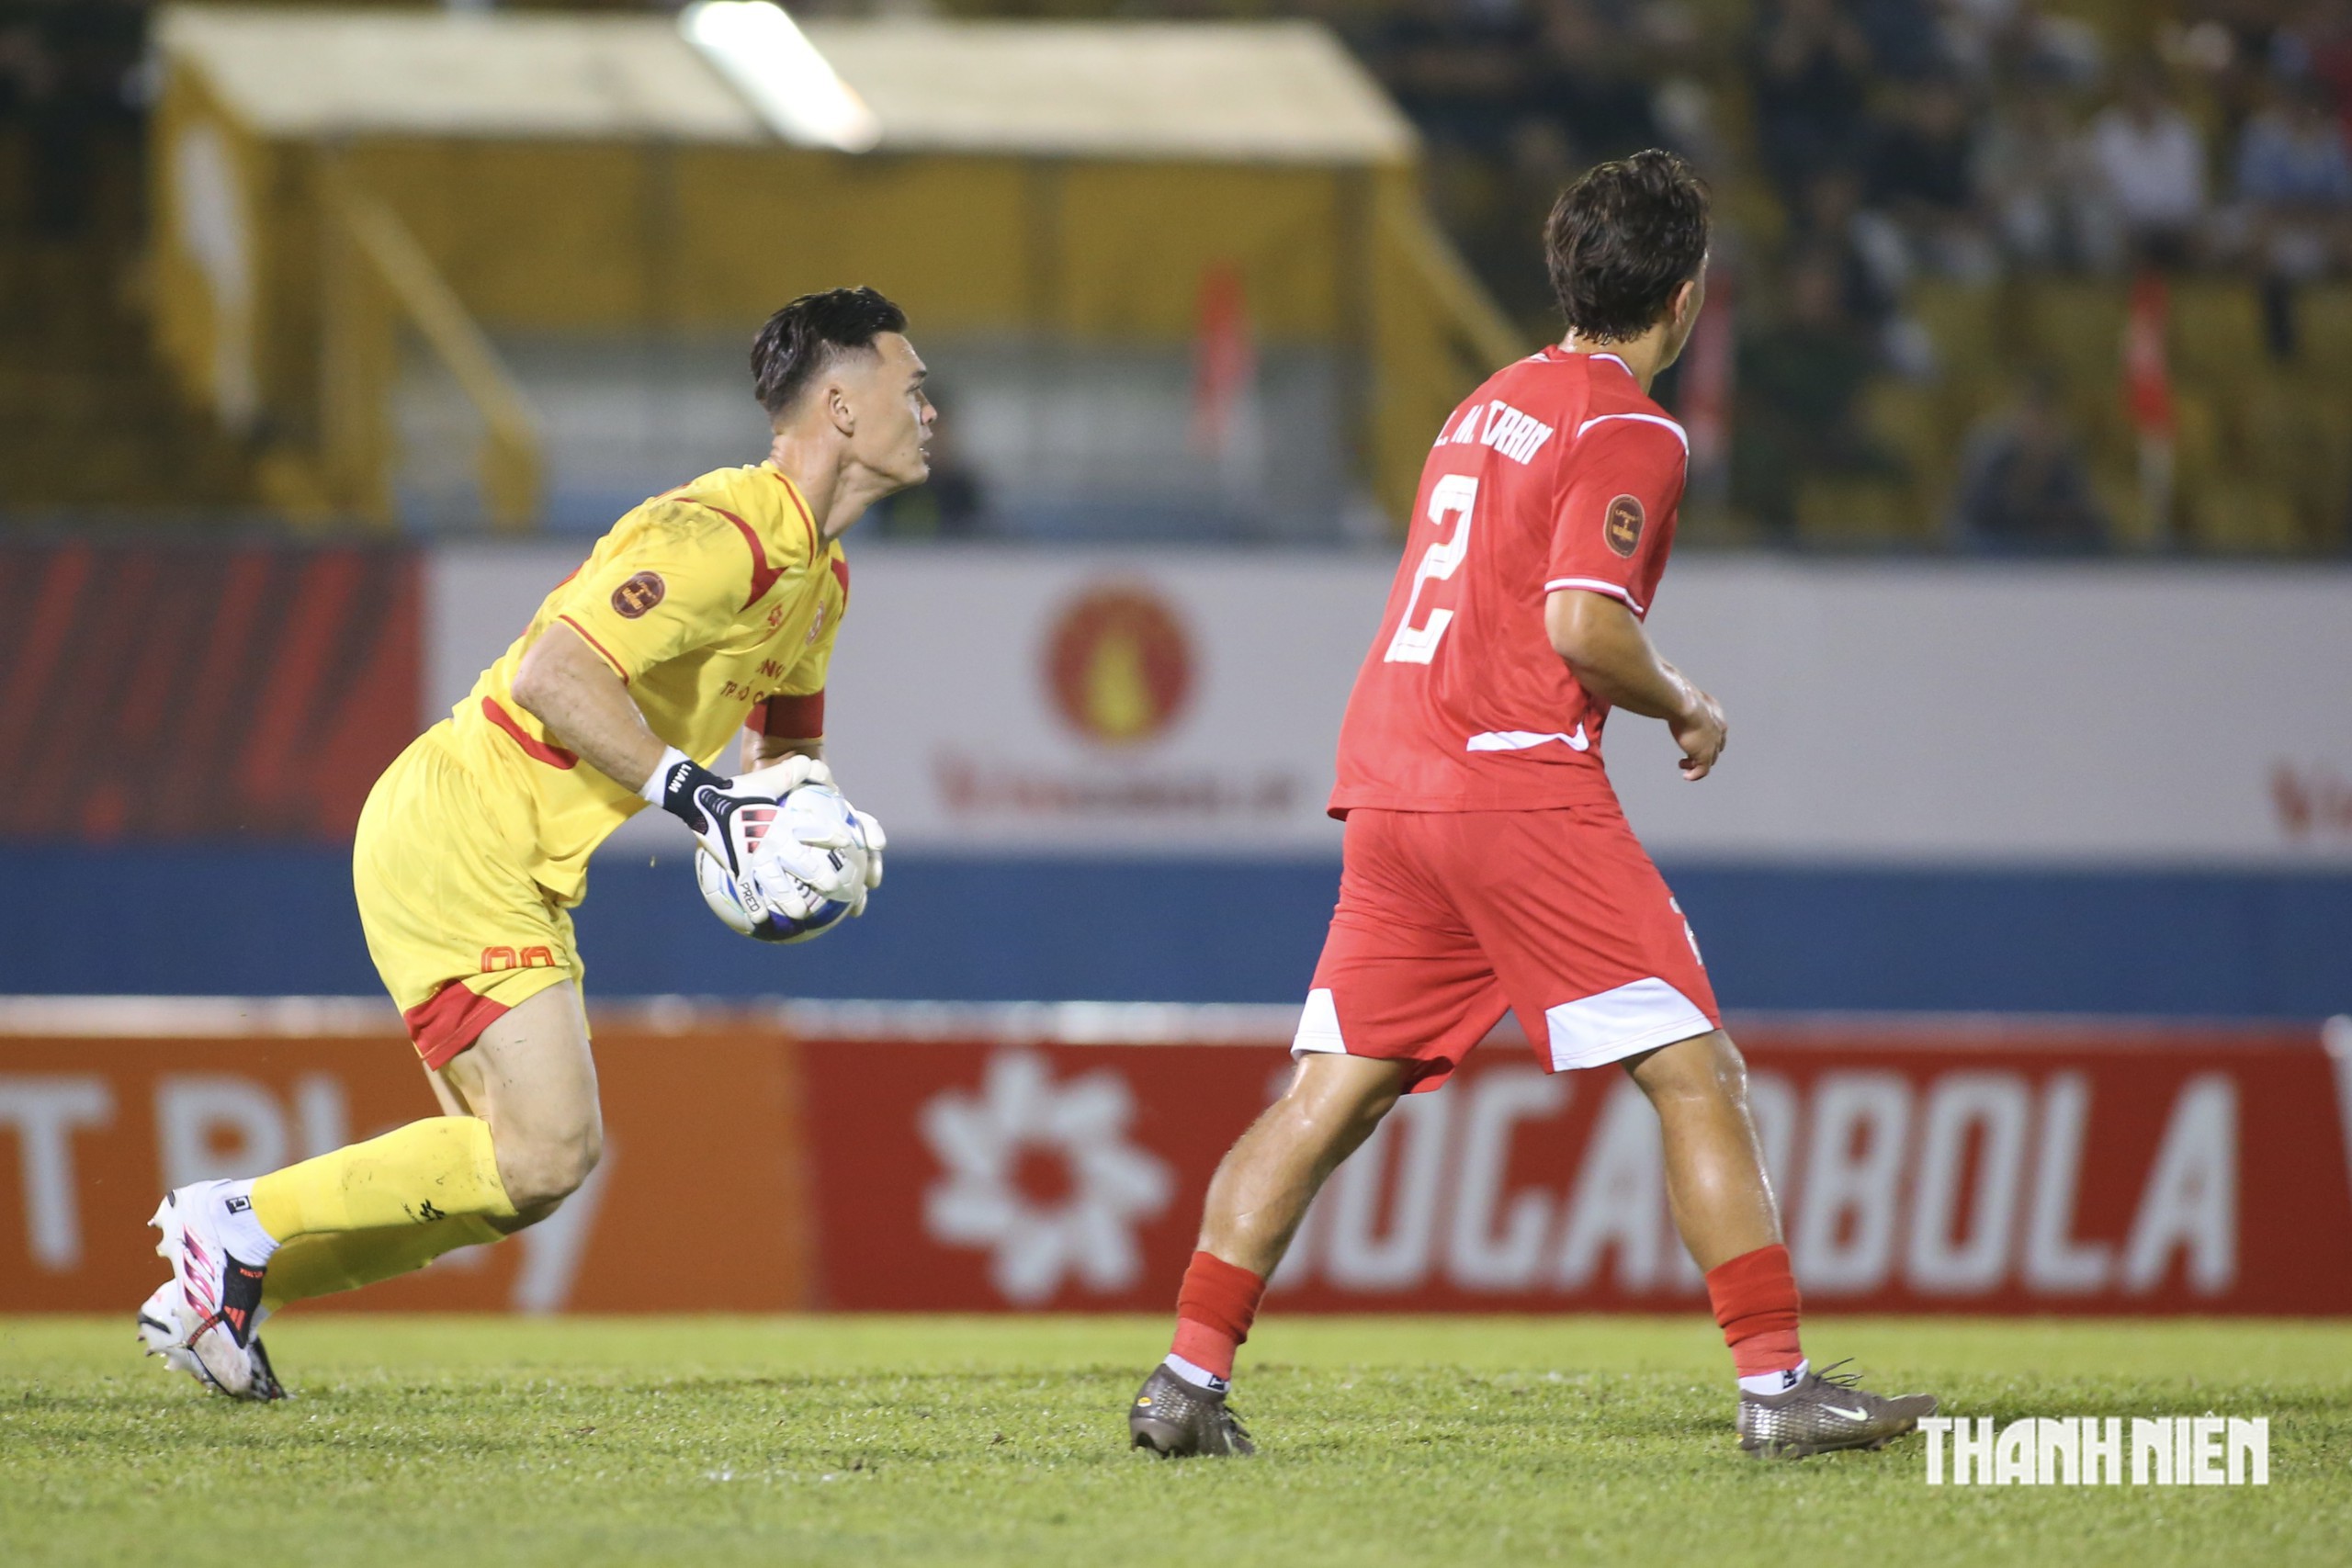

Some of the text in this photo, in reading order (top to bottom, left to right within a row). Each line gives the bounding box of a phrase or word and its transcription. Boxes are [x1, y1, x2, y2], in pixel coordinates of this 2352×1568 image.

[1384, 473, 1479, 665] 2
[668, 763, 692, 793] LIAM
[740, 882, 761, 912] PRED
[1266, 1066, 2244, 1297] OGABOLA
